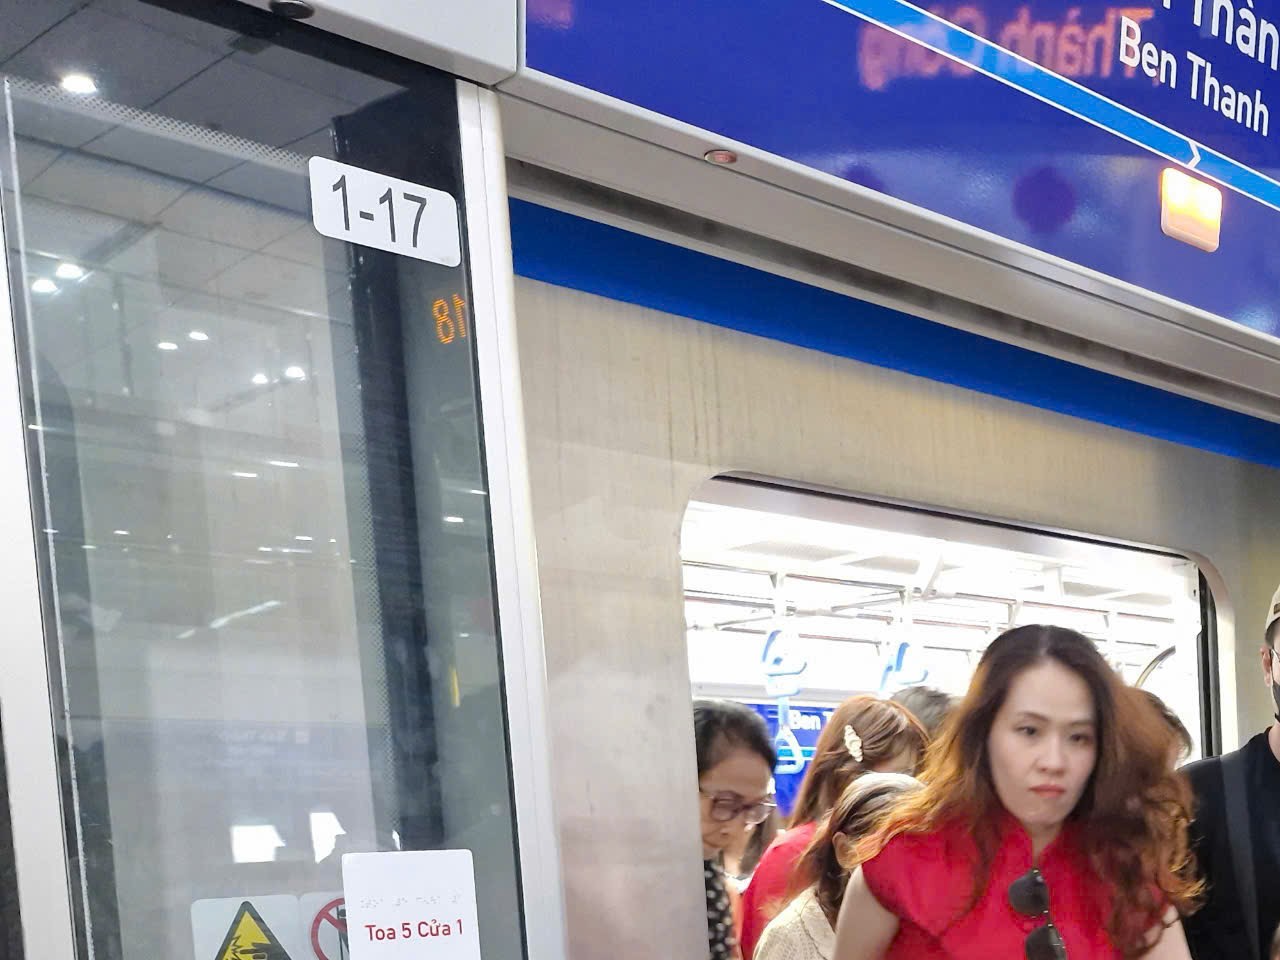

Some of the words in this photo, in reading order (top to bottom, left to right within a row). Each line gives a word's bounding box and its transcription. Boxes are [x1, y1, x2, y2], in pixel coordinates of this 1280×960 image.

[1119, 16, 1177, 89] Ben
[1187, 51, 1270, 137] Thanh
[332, 174, 427, 248] 1-17
[365, 924, 396, 941] Toa
[401, 922, 412, 939] 5
[418, 919, 451, 938] Cửa
[456, 918, 463, 935] 1
